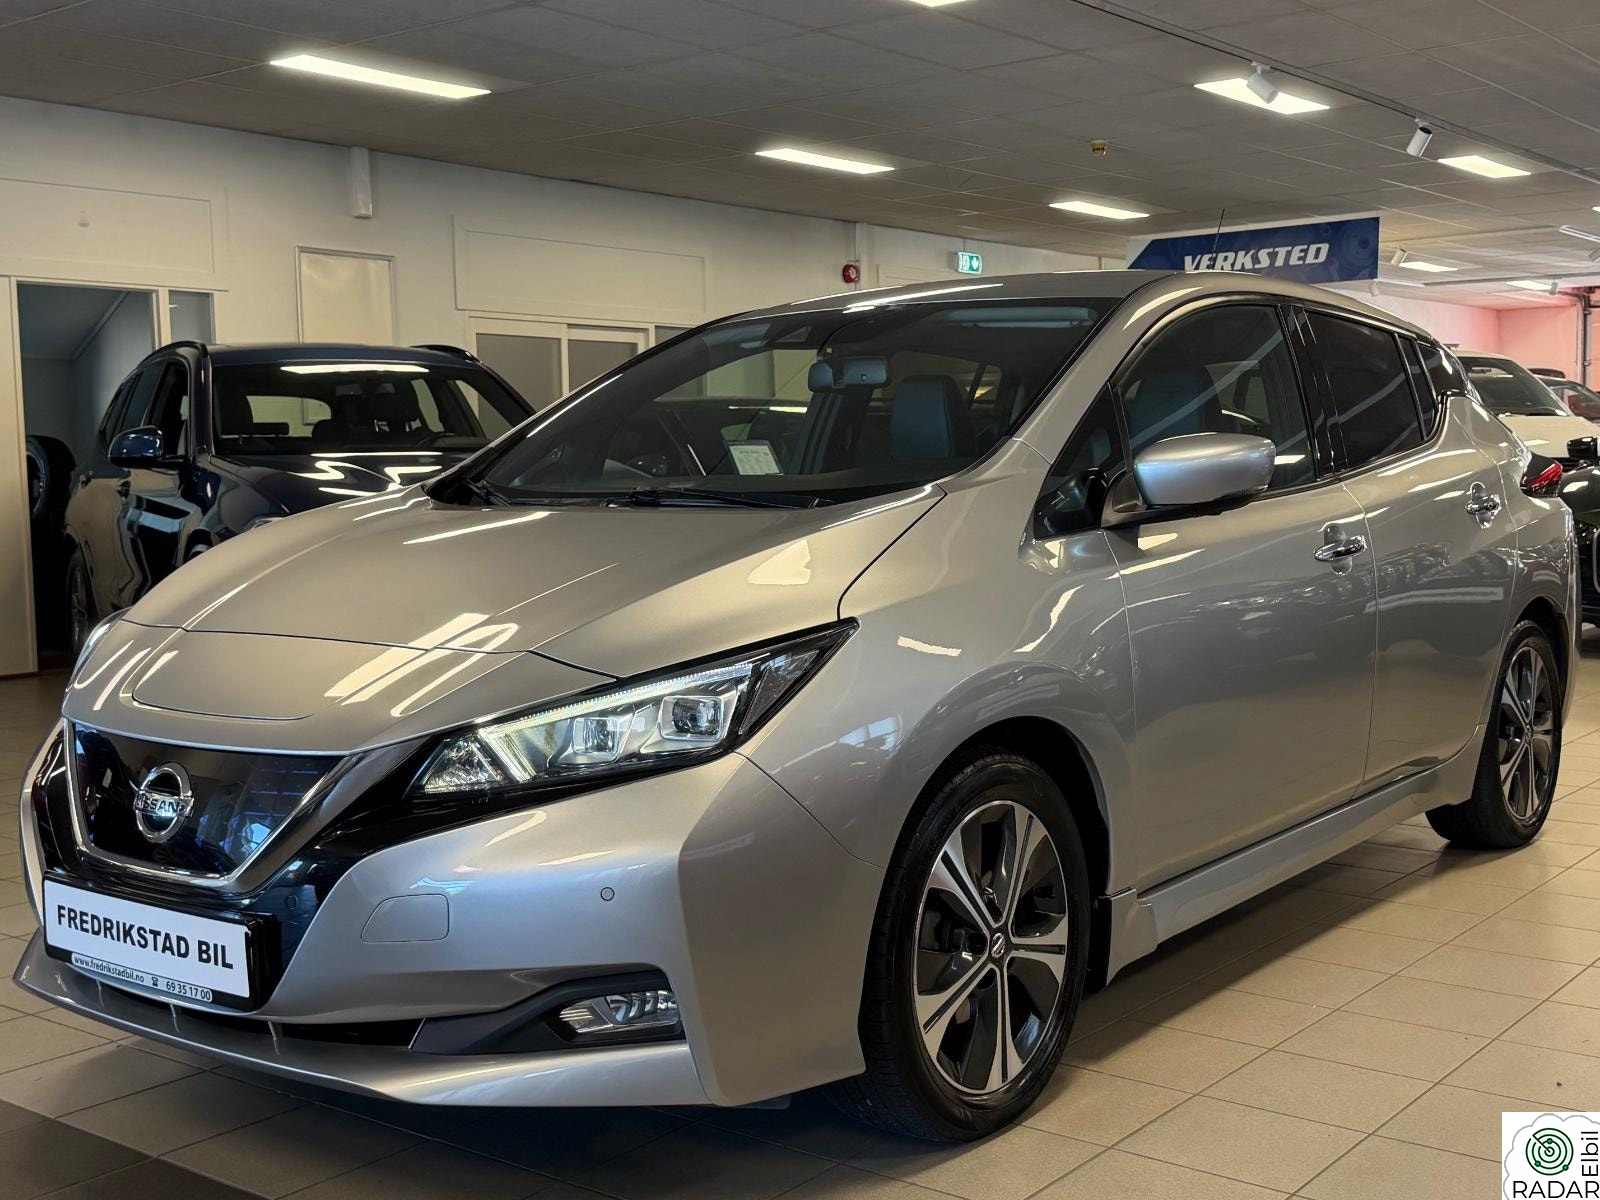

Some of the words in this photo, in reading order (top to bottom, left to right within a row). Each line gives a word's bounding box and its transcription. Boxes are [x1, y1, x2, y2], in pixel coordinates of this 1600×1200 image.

[1184, 243, 1330, 272] VERKSTED
[136, 794, 179, 813] NISSAN
[57, 904, 190, 959] FREDRIKSTAD
[198, 940, 234, 970] BIL
[74, 956, 145, 983] www.fredrikstadbil.no
[166, 980, 176, 992] 69
[178, 983, 188, 995] 35
[189, 986, 199, 998] 17
[200, 989, 211, 1001] 00
